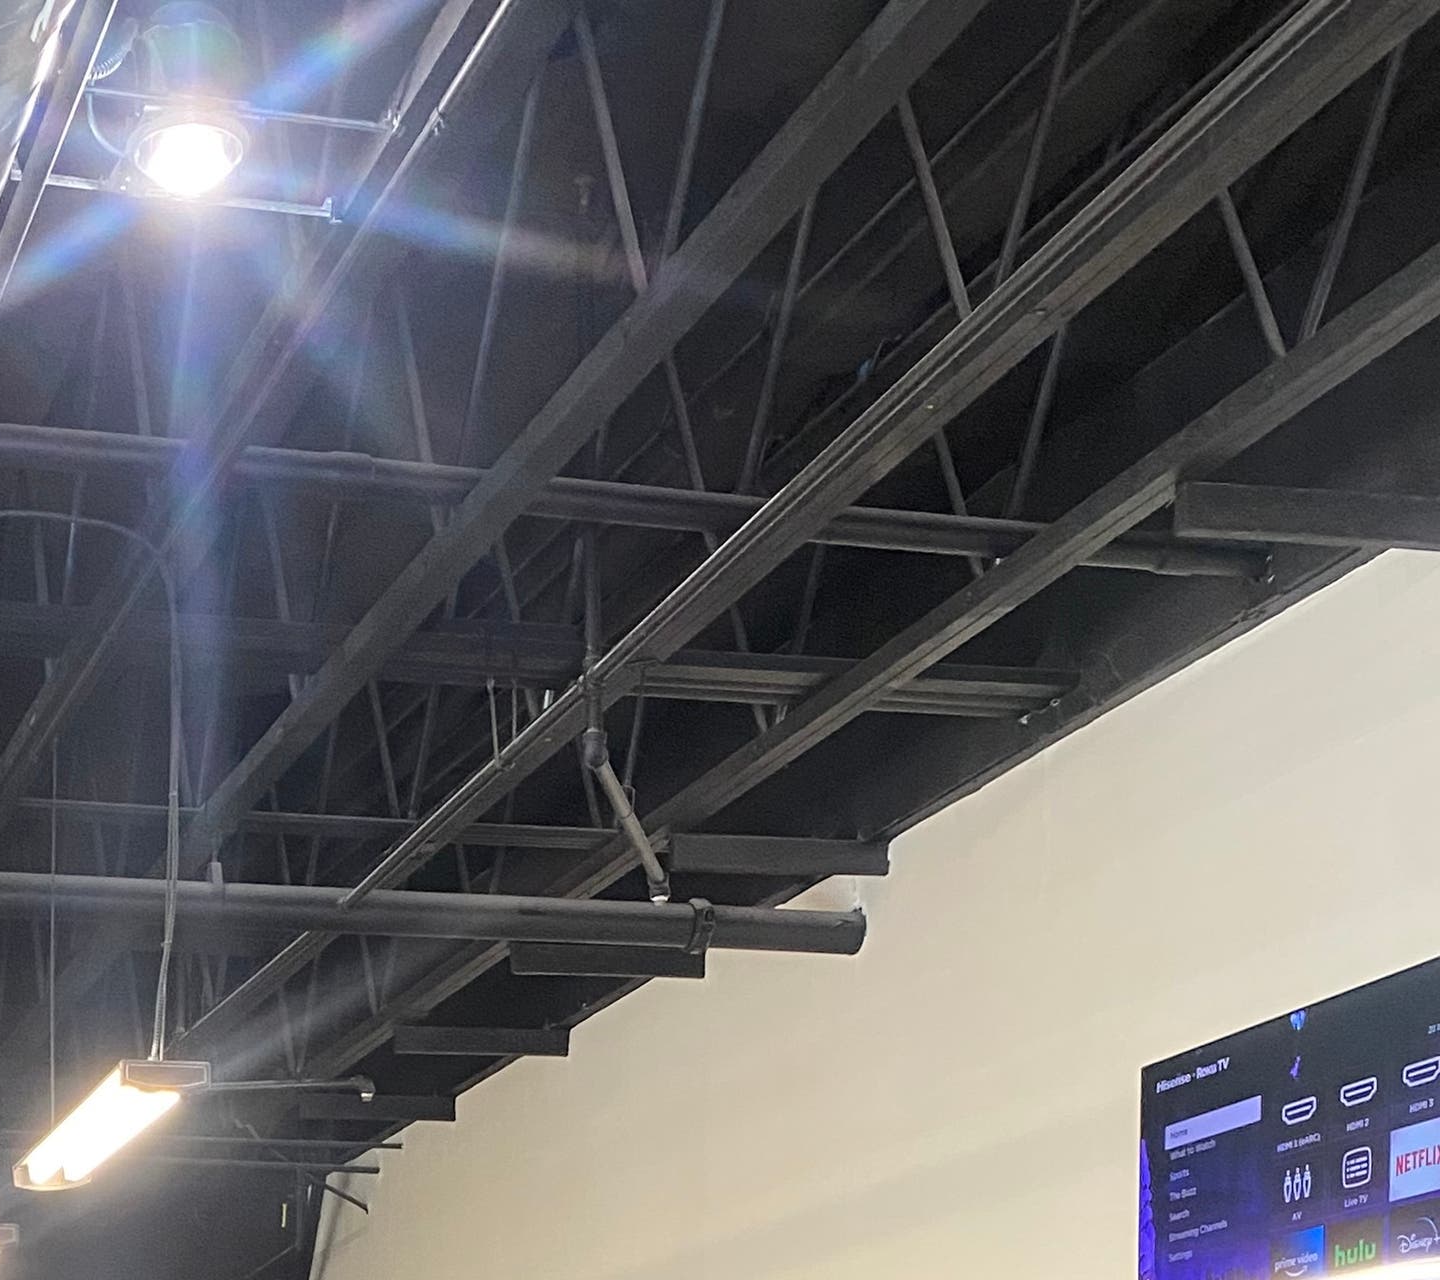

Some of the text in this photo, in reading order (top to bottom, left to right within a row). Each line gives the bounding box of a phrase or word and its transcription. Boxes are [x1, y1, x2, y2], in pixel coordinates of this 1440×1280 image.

[1156, 1056, 1231, 1094] Hisense Roku TV
[1344, 1194, 1369, 1209] Live TV
[1274, 1251, 1319, 1273] prime video
[1335, 1239, 1377, 1268] hulu
